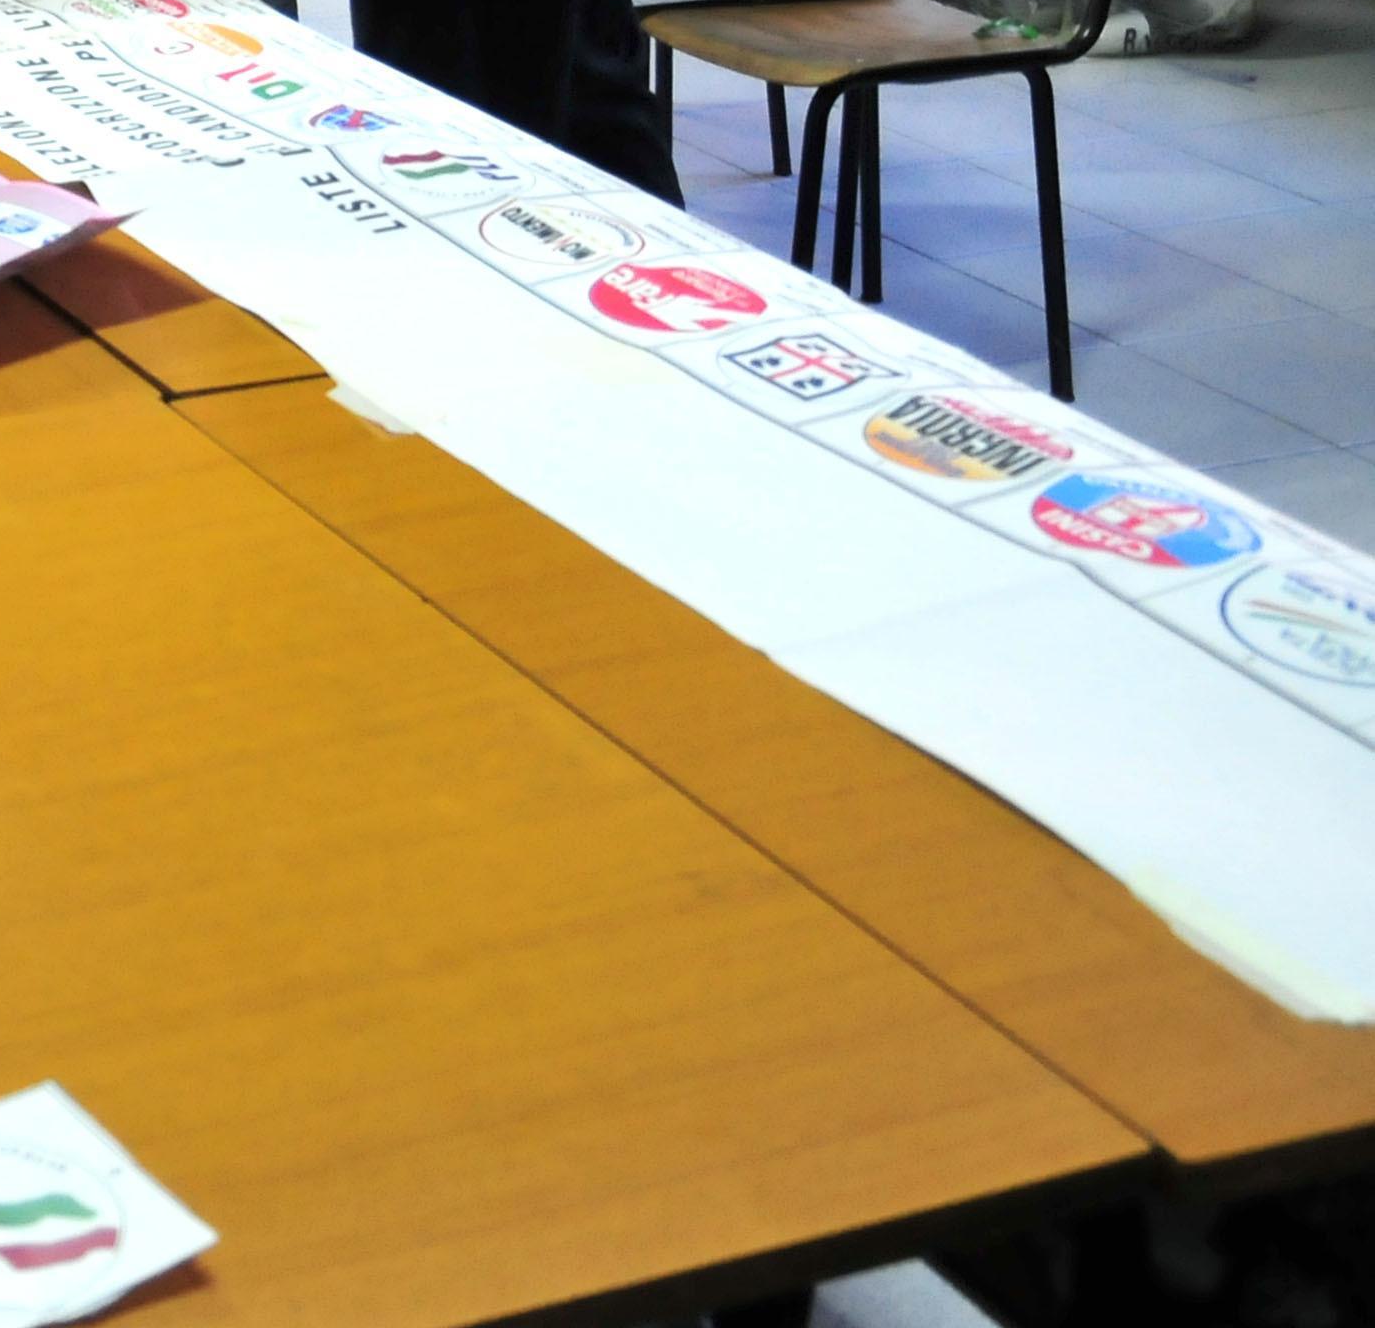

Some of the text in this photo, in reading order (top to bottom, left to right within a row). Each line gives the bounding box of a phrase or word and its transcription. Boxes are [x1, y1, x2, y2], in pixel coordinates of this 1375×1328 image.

[97, 70, 250, 142] CANDIDATI
[299, 172, 408, 235] LISTE
[886, 394, 1050, 477] INGROIA
[1038, 508, 1154, 562] CASINI
